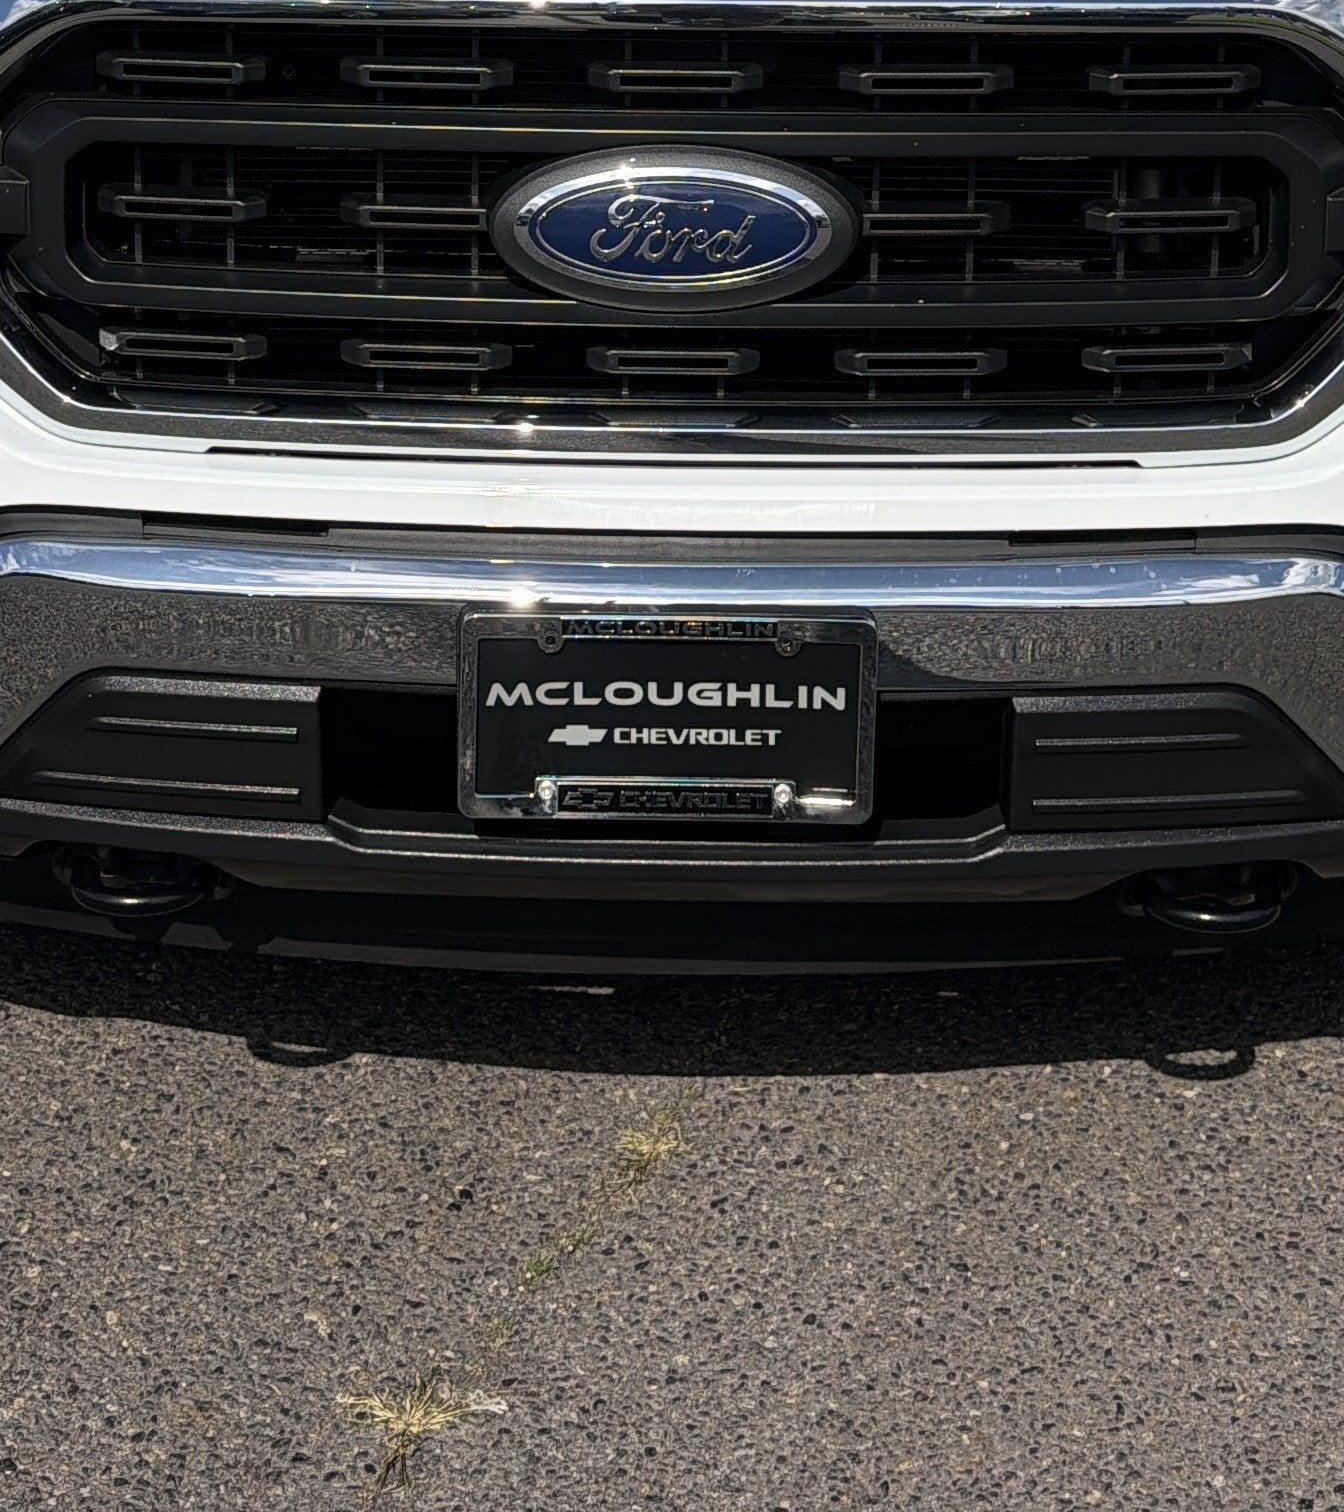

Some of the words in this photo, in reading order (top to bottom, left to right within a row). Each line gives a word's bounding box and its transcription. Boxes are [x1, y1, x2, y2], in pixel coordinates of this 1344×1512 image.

[590, 194, 756, 263] Ford
[566, 620, 774, 637] MCLOUGHLIN
[484, 680, 847, 711] MCLOUGHLIN
[613, 726, 782, 747] CHEVROLET
[619, 789, 769, 809] CHEVROLET
